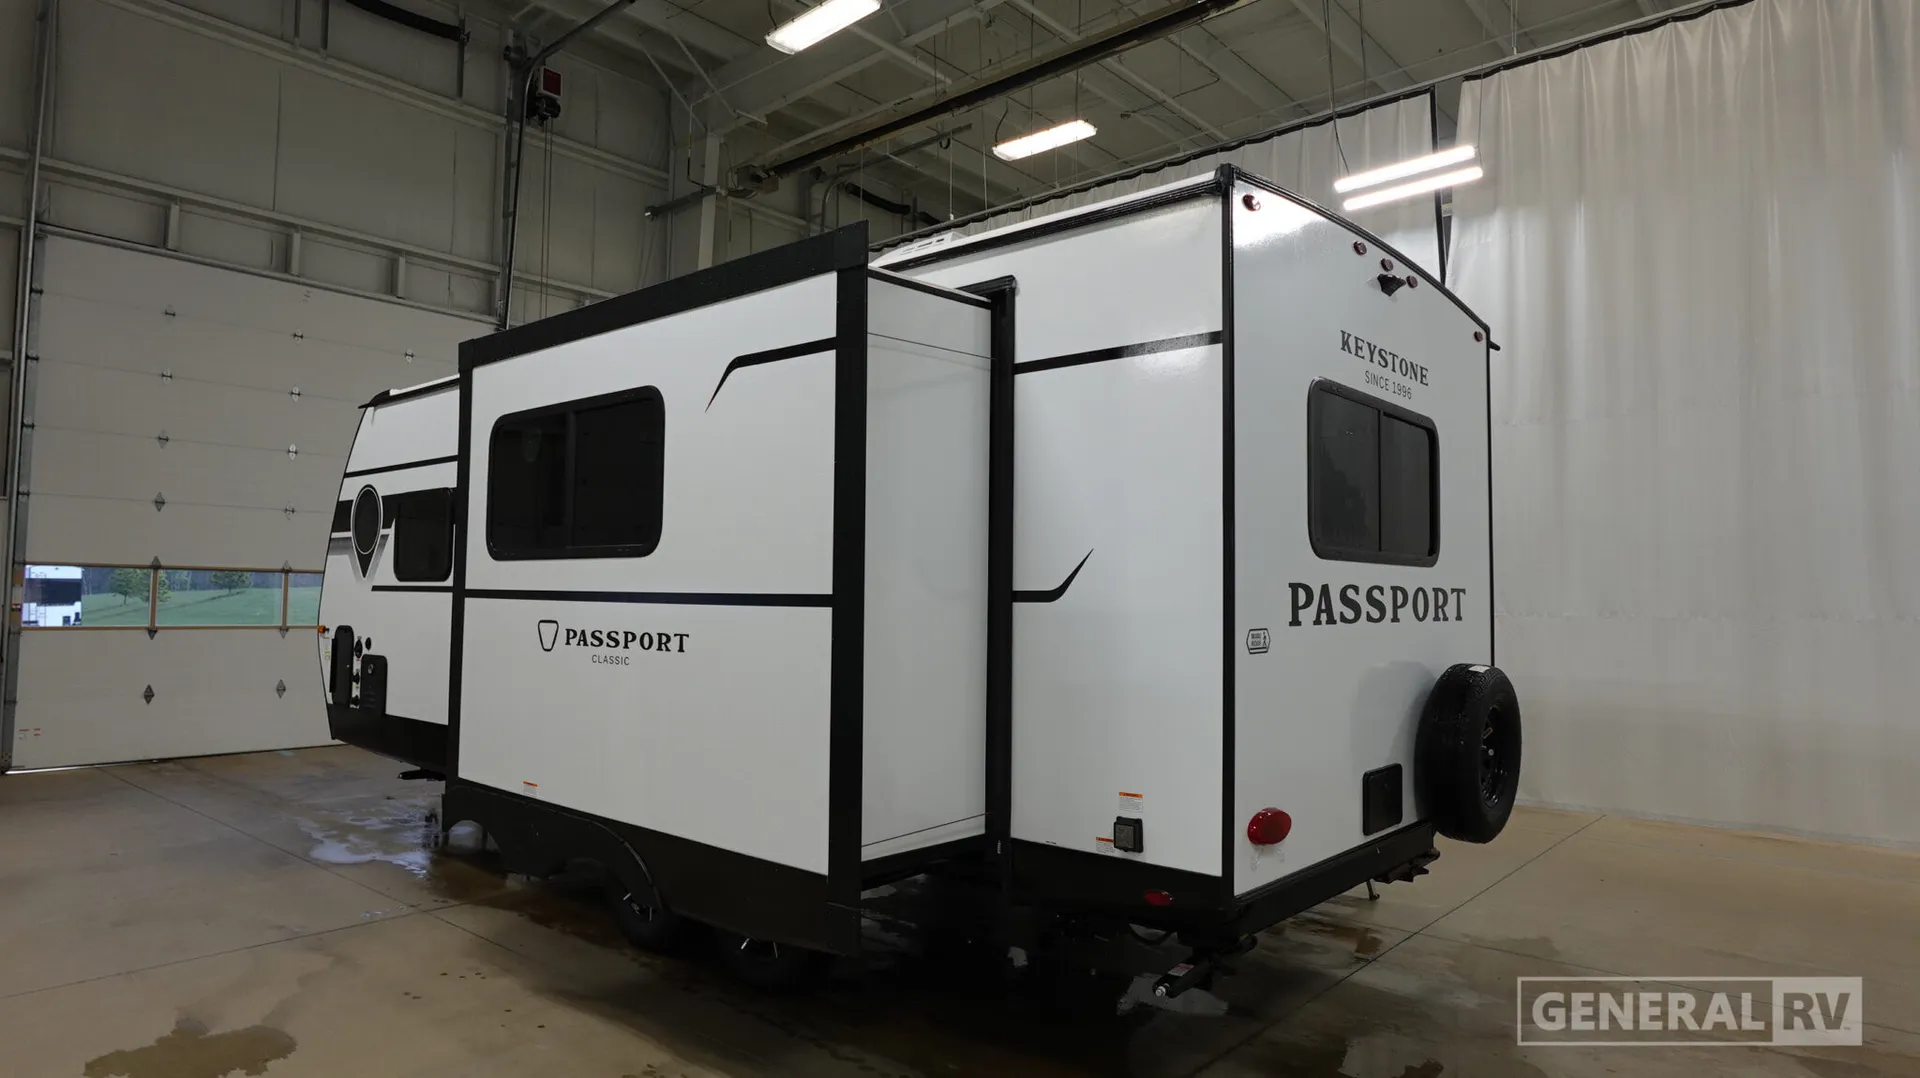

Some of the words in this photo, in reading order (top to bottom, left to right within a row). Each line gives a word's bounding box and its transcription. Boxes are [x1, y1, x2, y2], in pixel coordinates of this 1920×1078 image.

[1340, 329, 1428, 386] KEYSTONE
[1364, 370, 1390, 391] SINCE
[1392, 381, 1412, 400] 1996
[1288, 582, 1466, 627] PASSPORT
[564, 628, 690, 653] PASSPORT
[591, 654, 630, 666] CLASSIC
